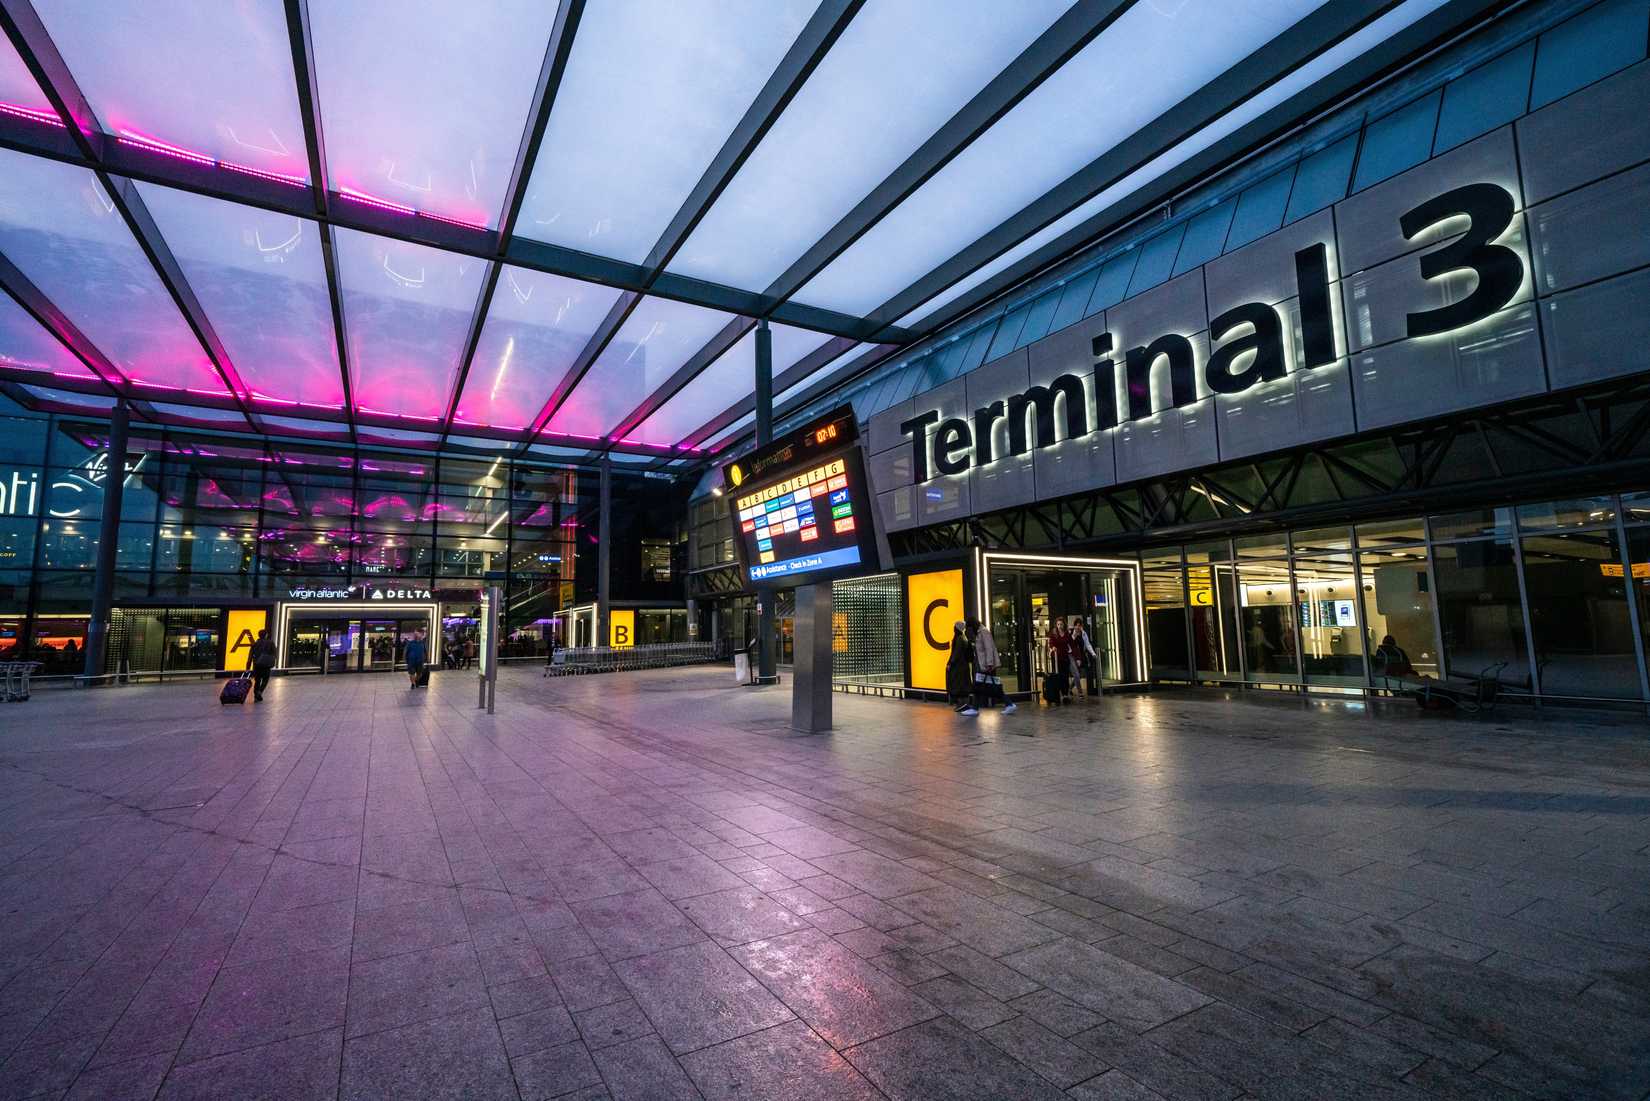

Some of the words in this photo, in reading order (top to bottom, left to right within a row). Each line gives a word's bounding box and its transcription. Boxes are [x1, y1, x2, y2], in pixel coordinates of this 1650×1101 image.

[900, 242, 1337, 485] Terminal
[1400, 182, 1524, 338] 3
[831, 463, 837, 474] G
[289, 588, 316, 600] virgin
[316, 588, 349, 599] atlantic
[387, 590, 431, 599] DELTA
[1196, 592, 1207, 604] C
[923, 598, 950, 651] C
[230, 629, 257, 653] A
[615, 625, 628, 644] B
